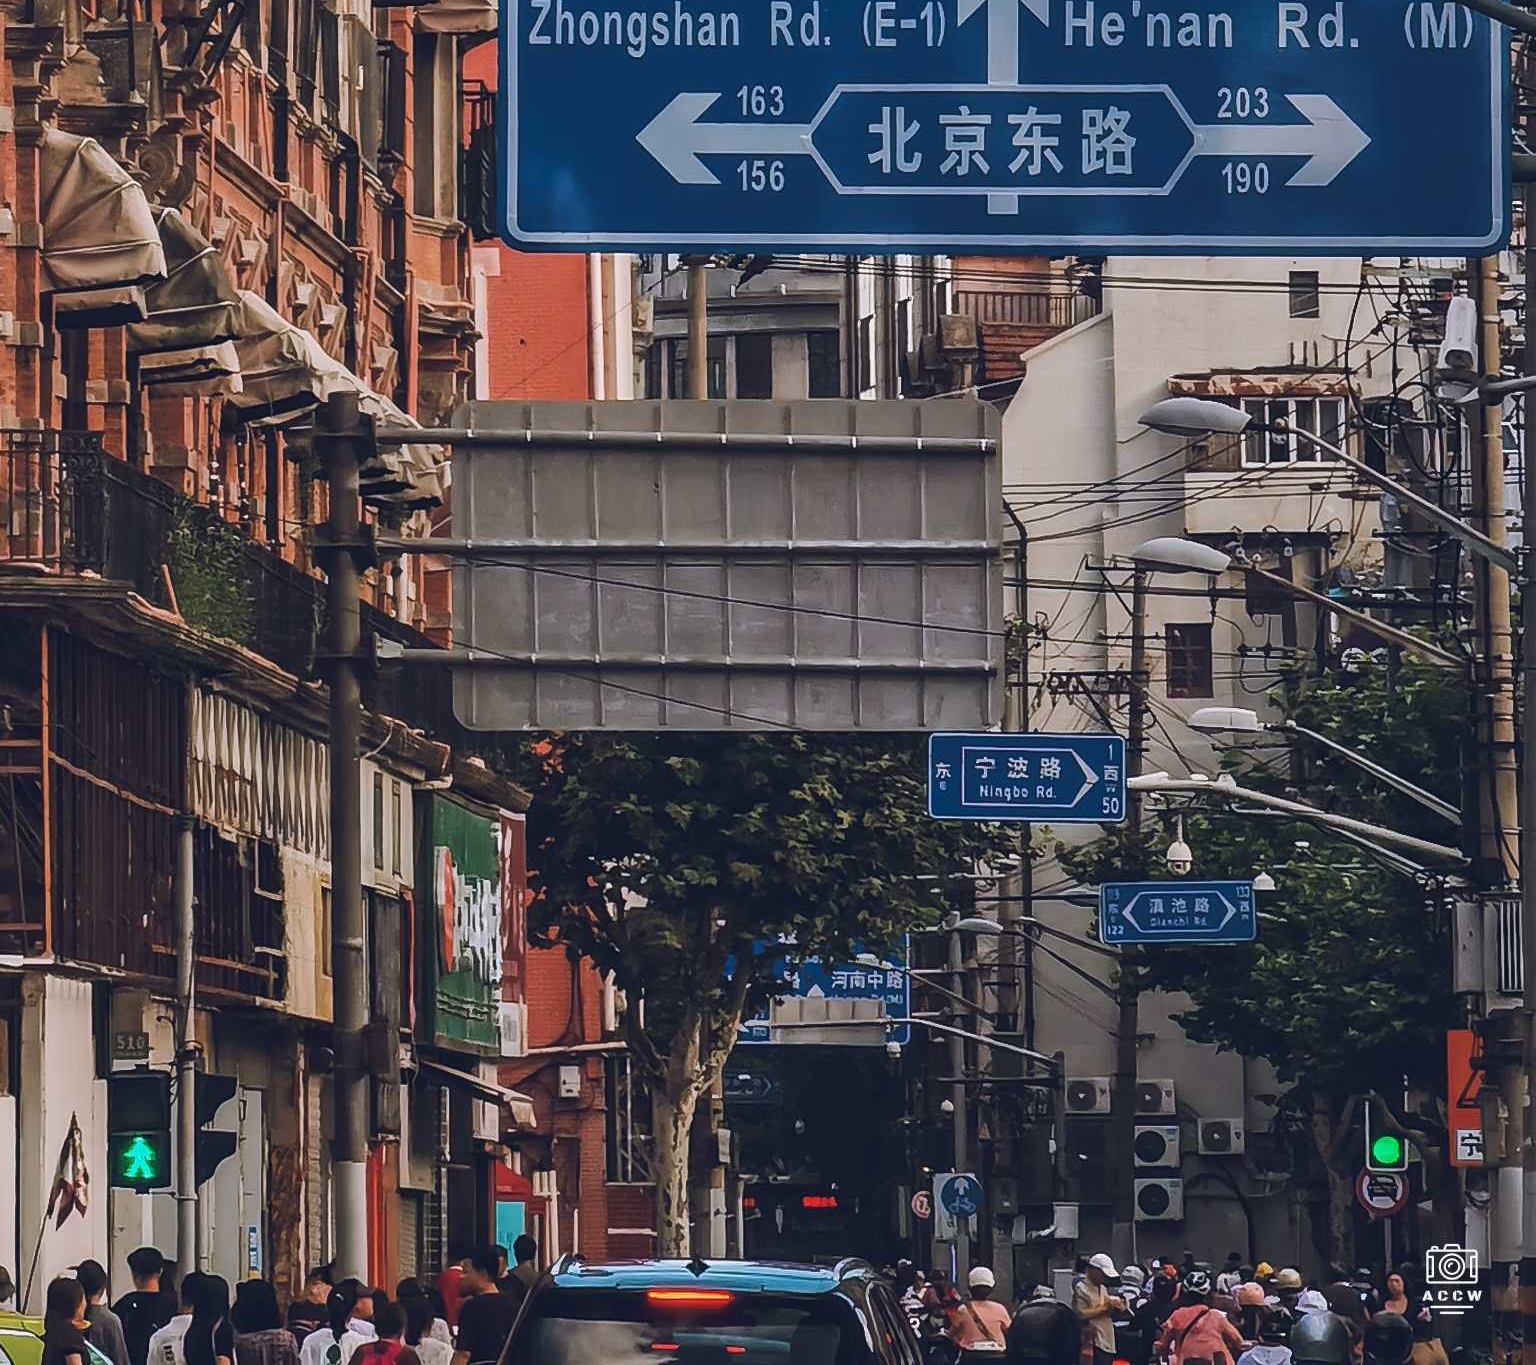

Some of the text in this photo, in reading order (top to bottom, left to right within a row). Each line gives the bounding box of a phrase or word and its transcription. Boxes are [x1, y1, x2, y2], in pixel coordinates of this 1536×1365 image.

[528, 0, 947, 58] Zhongshan Rd. (E-1)
[1064, 0, 1474, 49] He'nan Rd. (M)
[736, 85, 785, 117] 163
[1216, 87, 1270, 119] 203
[866, 105, 1138, 177] 北京东路
[736, 159, 786, 193] 156
[1220, 162, 1270, 195] 190
[935, 762, 952, 779] 东
[973, 756, 1062, 779] 宁波路
[1103, 764, 1120, 782] 西
[979, 784, 1057, 802] Ningbo Rd.
[1102, 796, 1120, 814] 50
